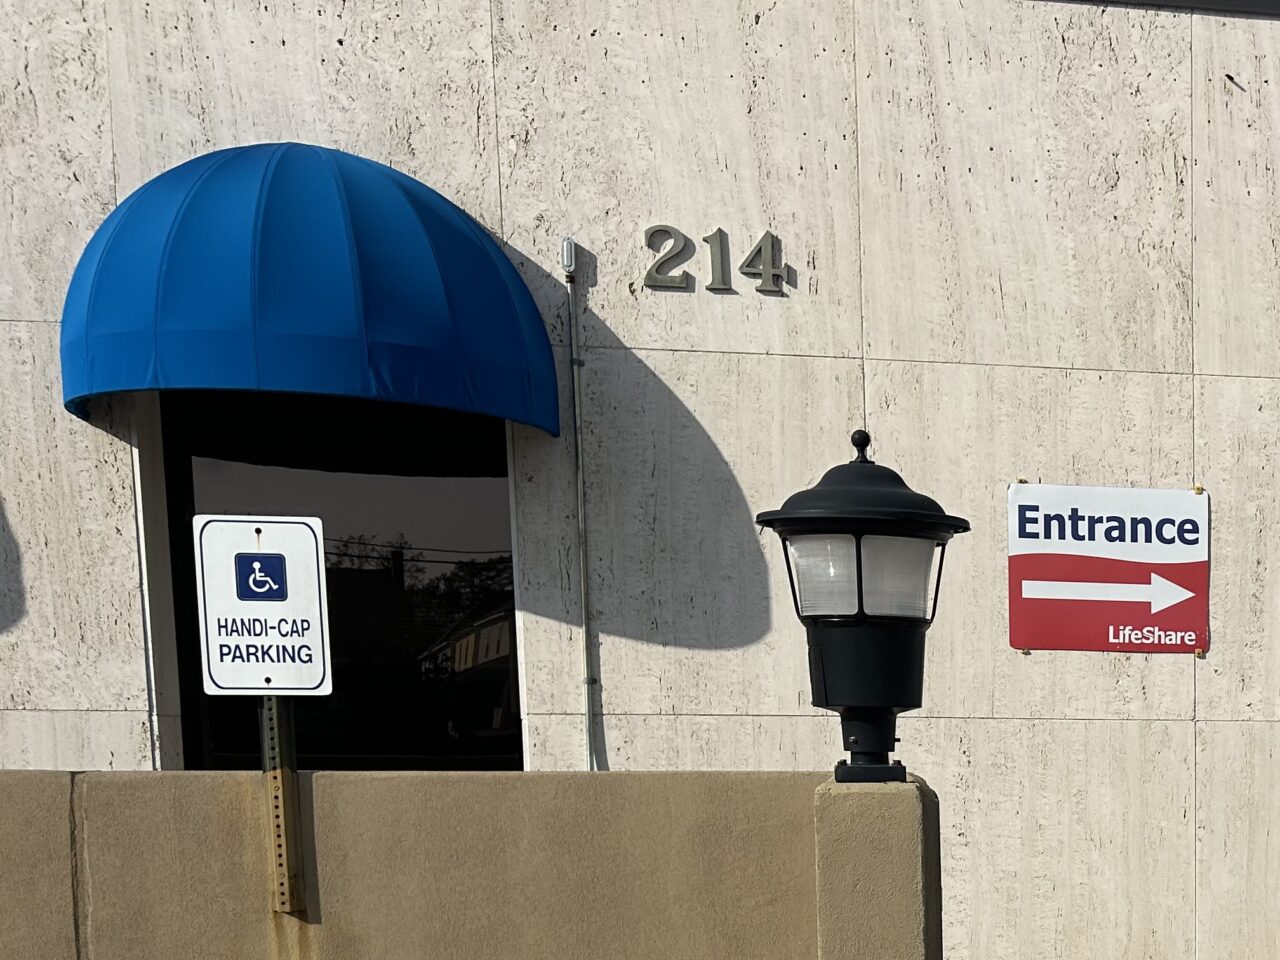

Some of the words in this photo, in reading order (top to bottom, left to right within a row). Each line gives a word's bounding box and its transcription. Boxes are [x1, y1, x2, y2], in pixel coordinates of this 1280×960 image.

[644, 224, 789, 292] 214
[1017, 504, 1200, 546] Entrance
[217, 617, 311, 638] HANDI-CAP
[1108, 625, 1197, 645] LifeShare
[218, 643, 313, 664] PARKING
